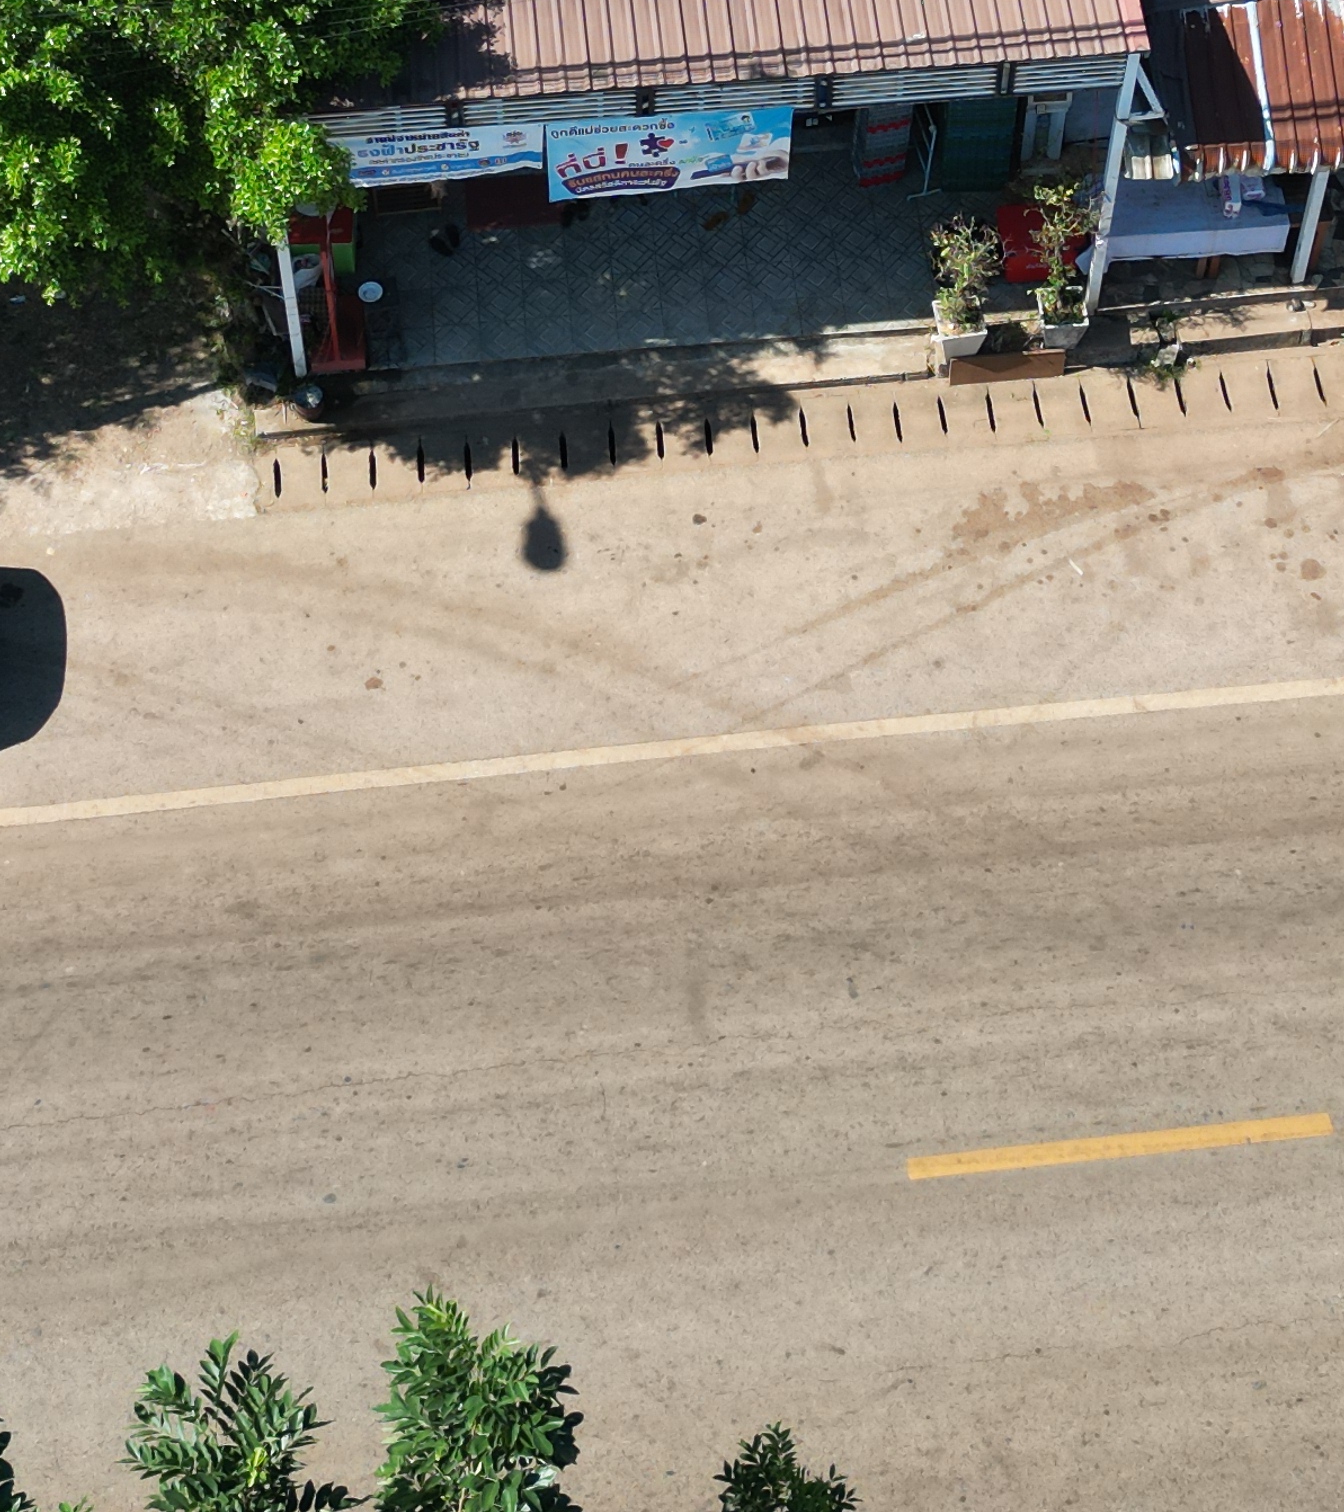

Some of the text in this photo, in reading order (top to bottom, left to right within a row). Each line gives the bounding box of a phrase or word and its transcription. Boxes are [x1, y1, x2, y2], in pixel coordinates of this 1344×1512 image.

[356, 138, 480, 158] ธงฟ้าประชารัฐ
